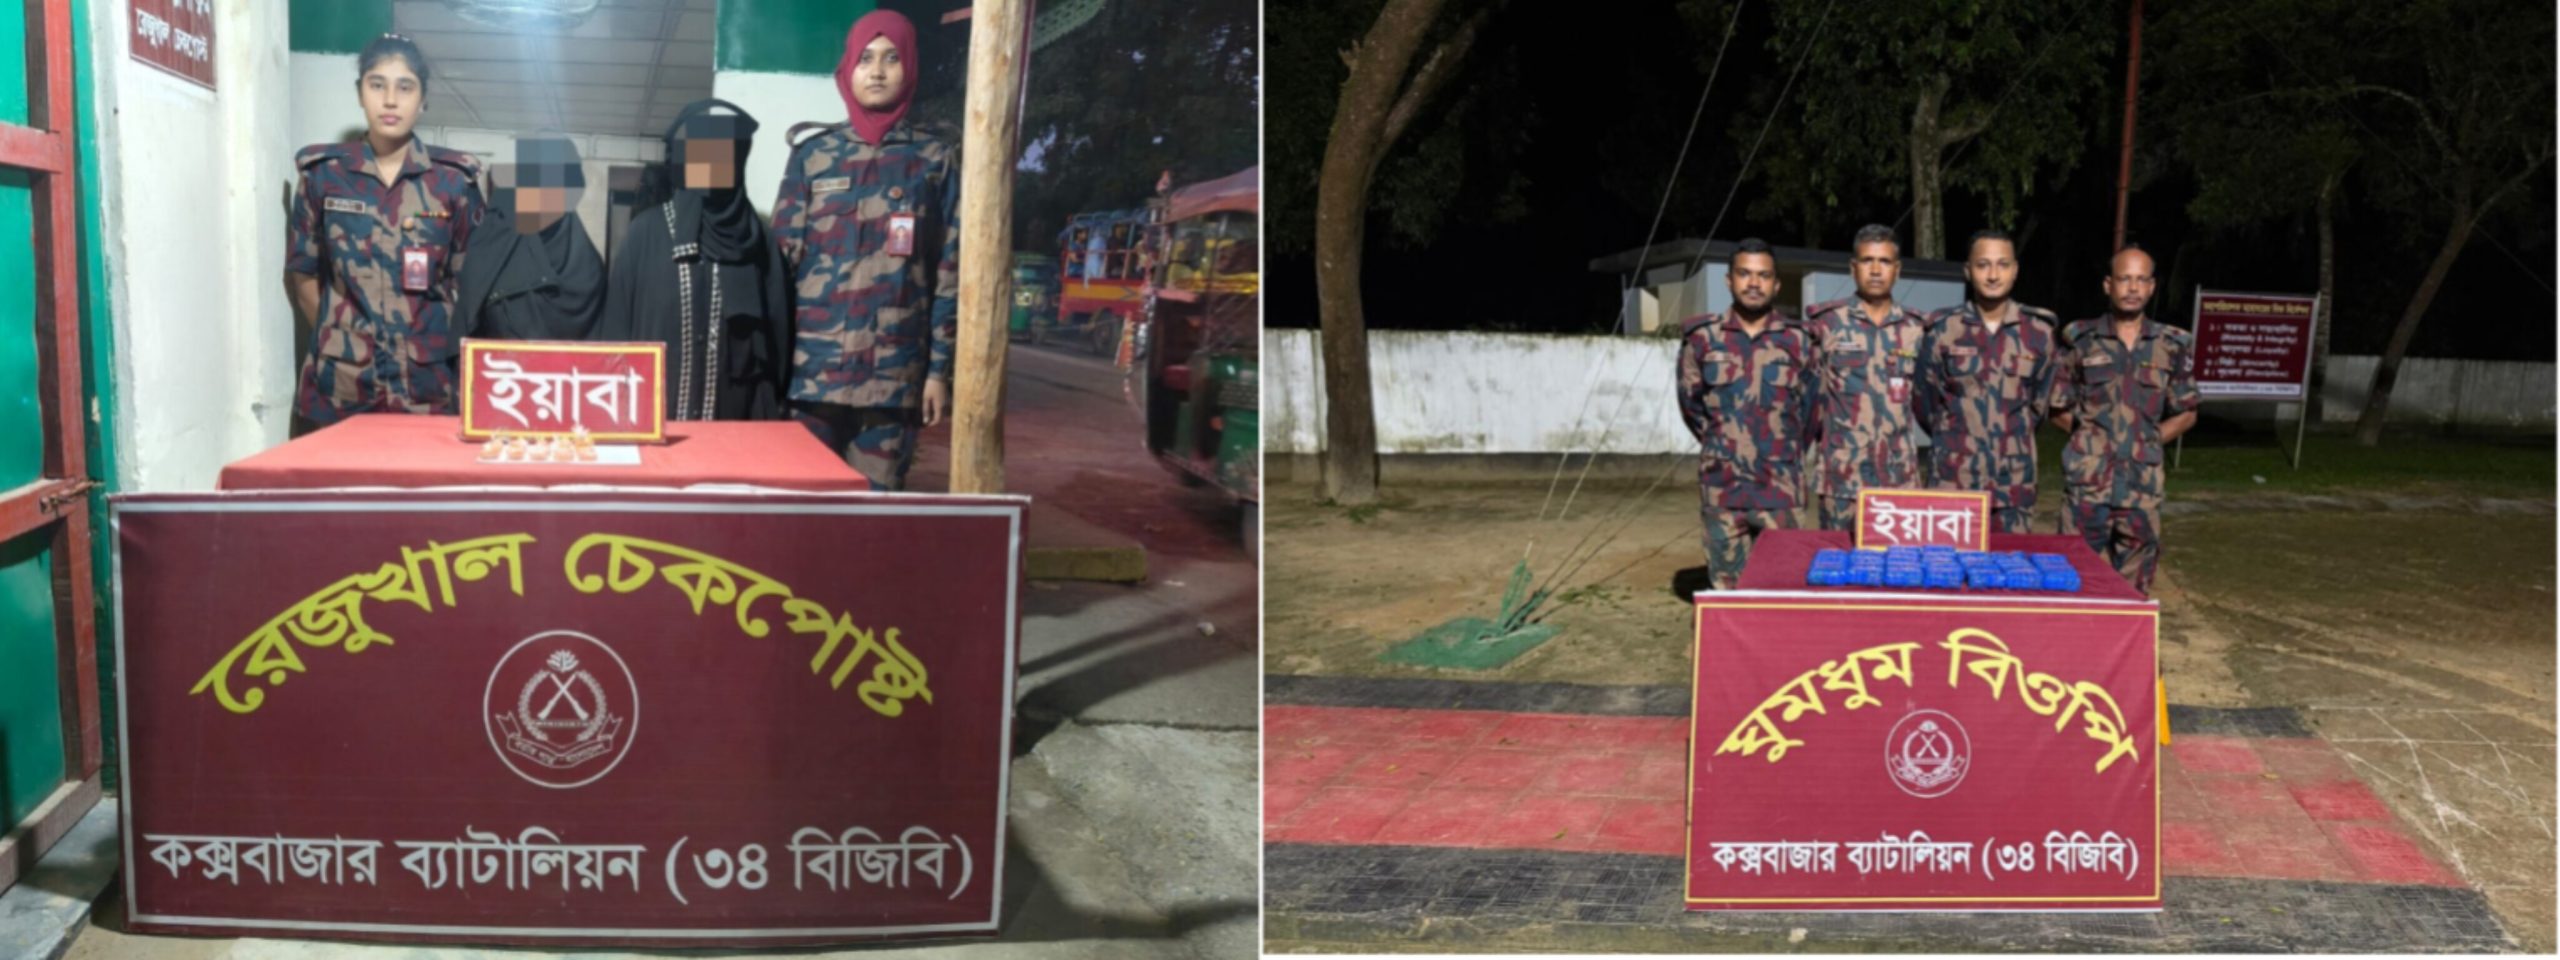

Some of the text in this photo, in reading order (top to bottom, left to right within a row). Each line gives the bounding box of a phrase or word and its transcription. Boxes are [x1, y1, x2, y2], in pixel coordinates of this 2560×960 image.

[481, 352, 645, 428] ইয়াবা
[1869, 497, 1974, 543] ইয়াবা
[189, 533, 933, 718] রেজুখাল চেকপোষ্ট
[1714, 627, 2139, 773] ঘুমধুম বিওপি
[143, 825, 973, 905] কক্সবাজার ব্যাটালিয়ন (৩৪ বিজিবি)
[1710, 830, 2139, 881] কক্সবাজার ব্যাটালিয়ন (৩৪ বিজিবি)
